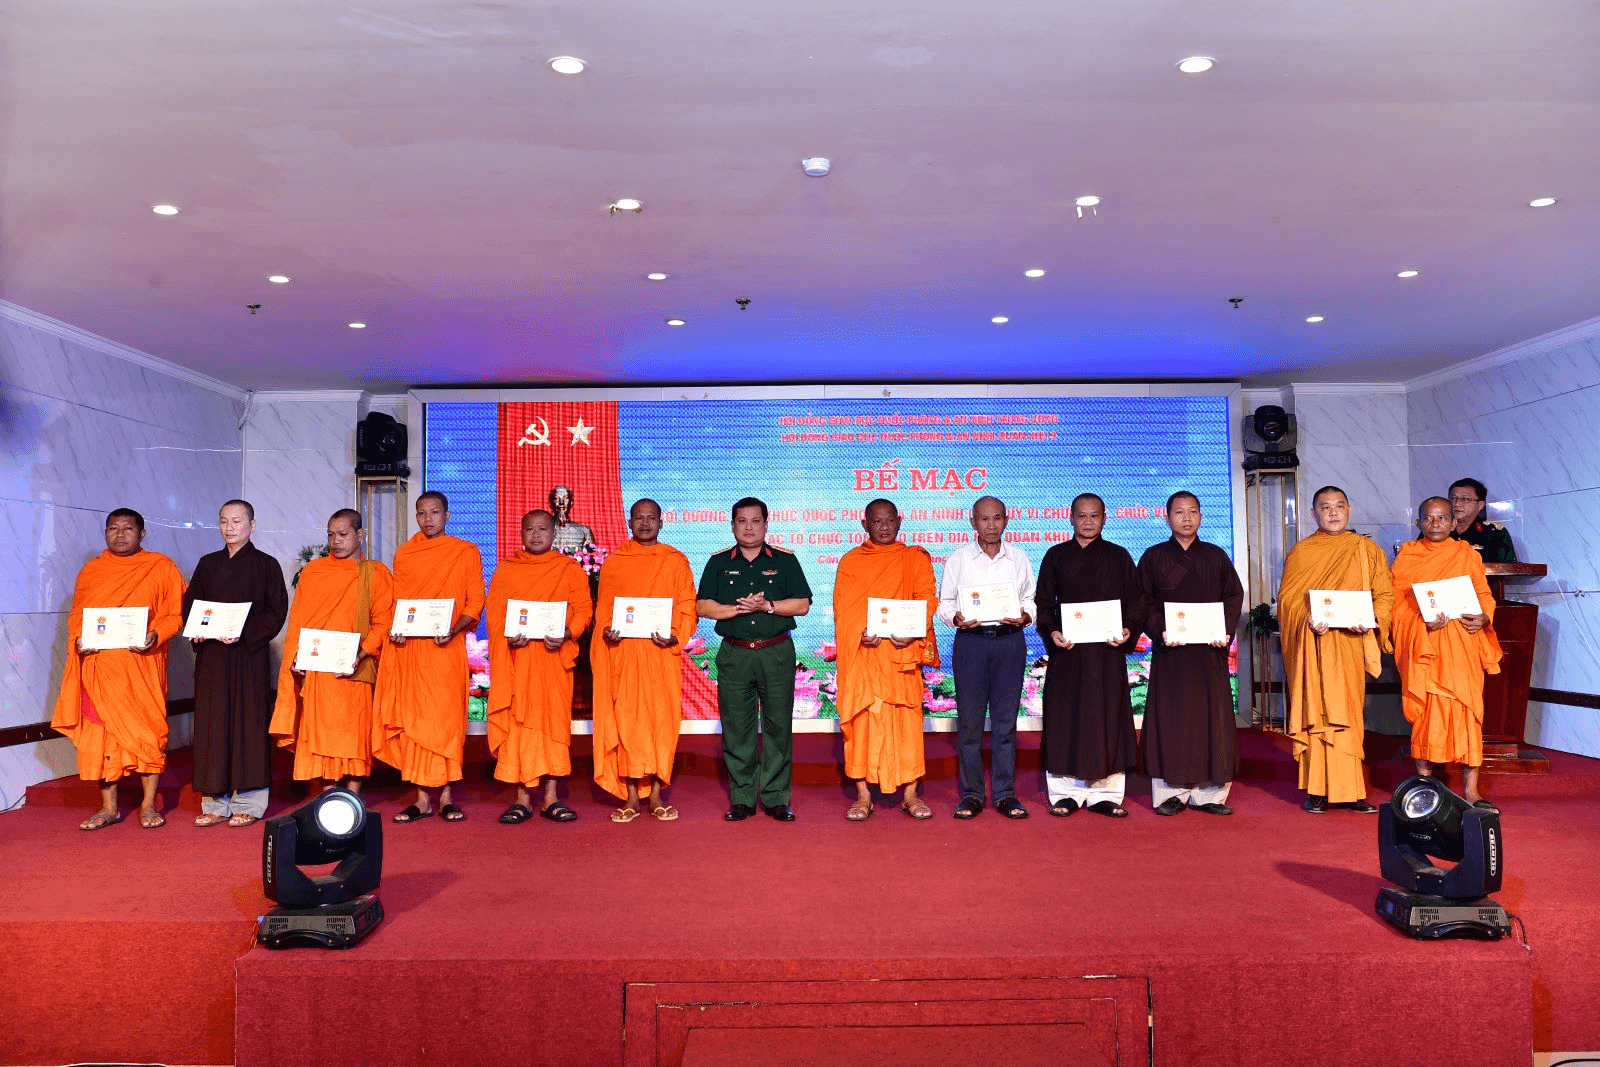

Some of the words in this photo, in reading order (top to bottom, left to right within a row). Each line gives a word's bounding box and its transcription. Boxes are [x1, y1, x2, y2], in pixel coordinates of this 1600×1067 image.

[853, 457, 900, 490] BẾ
[908, 467, 987, 496] MẠC
[931, 508, 964, 520] NINH
